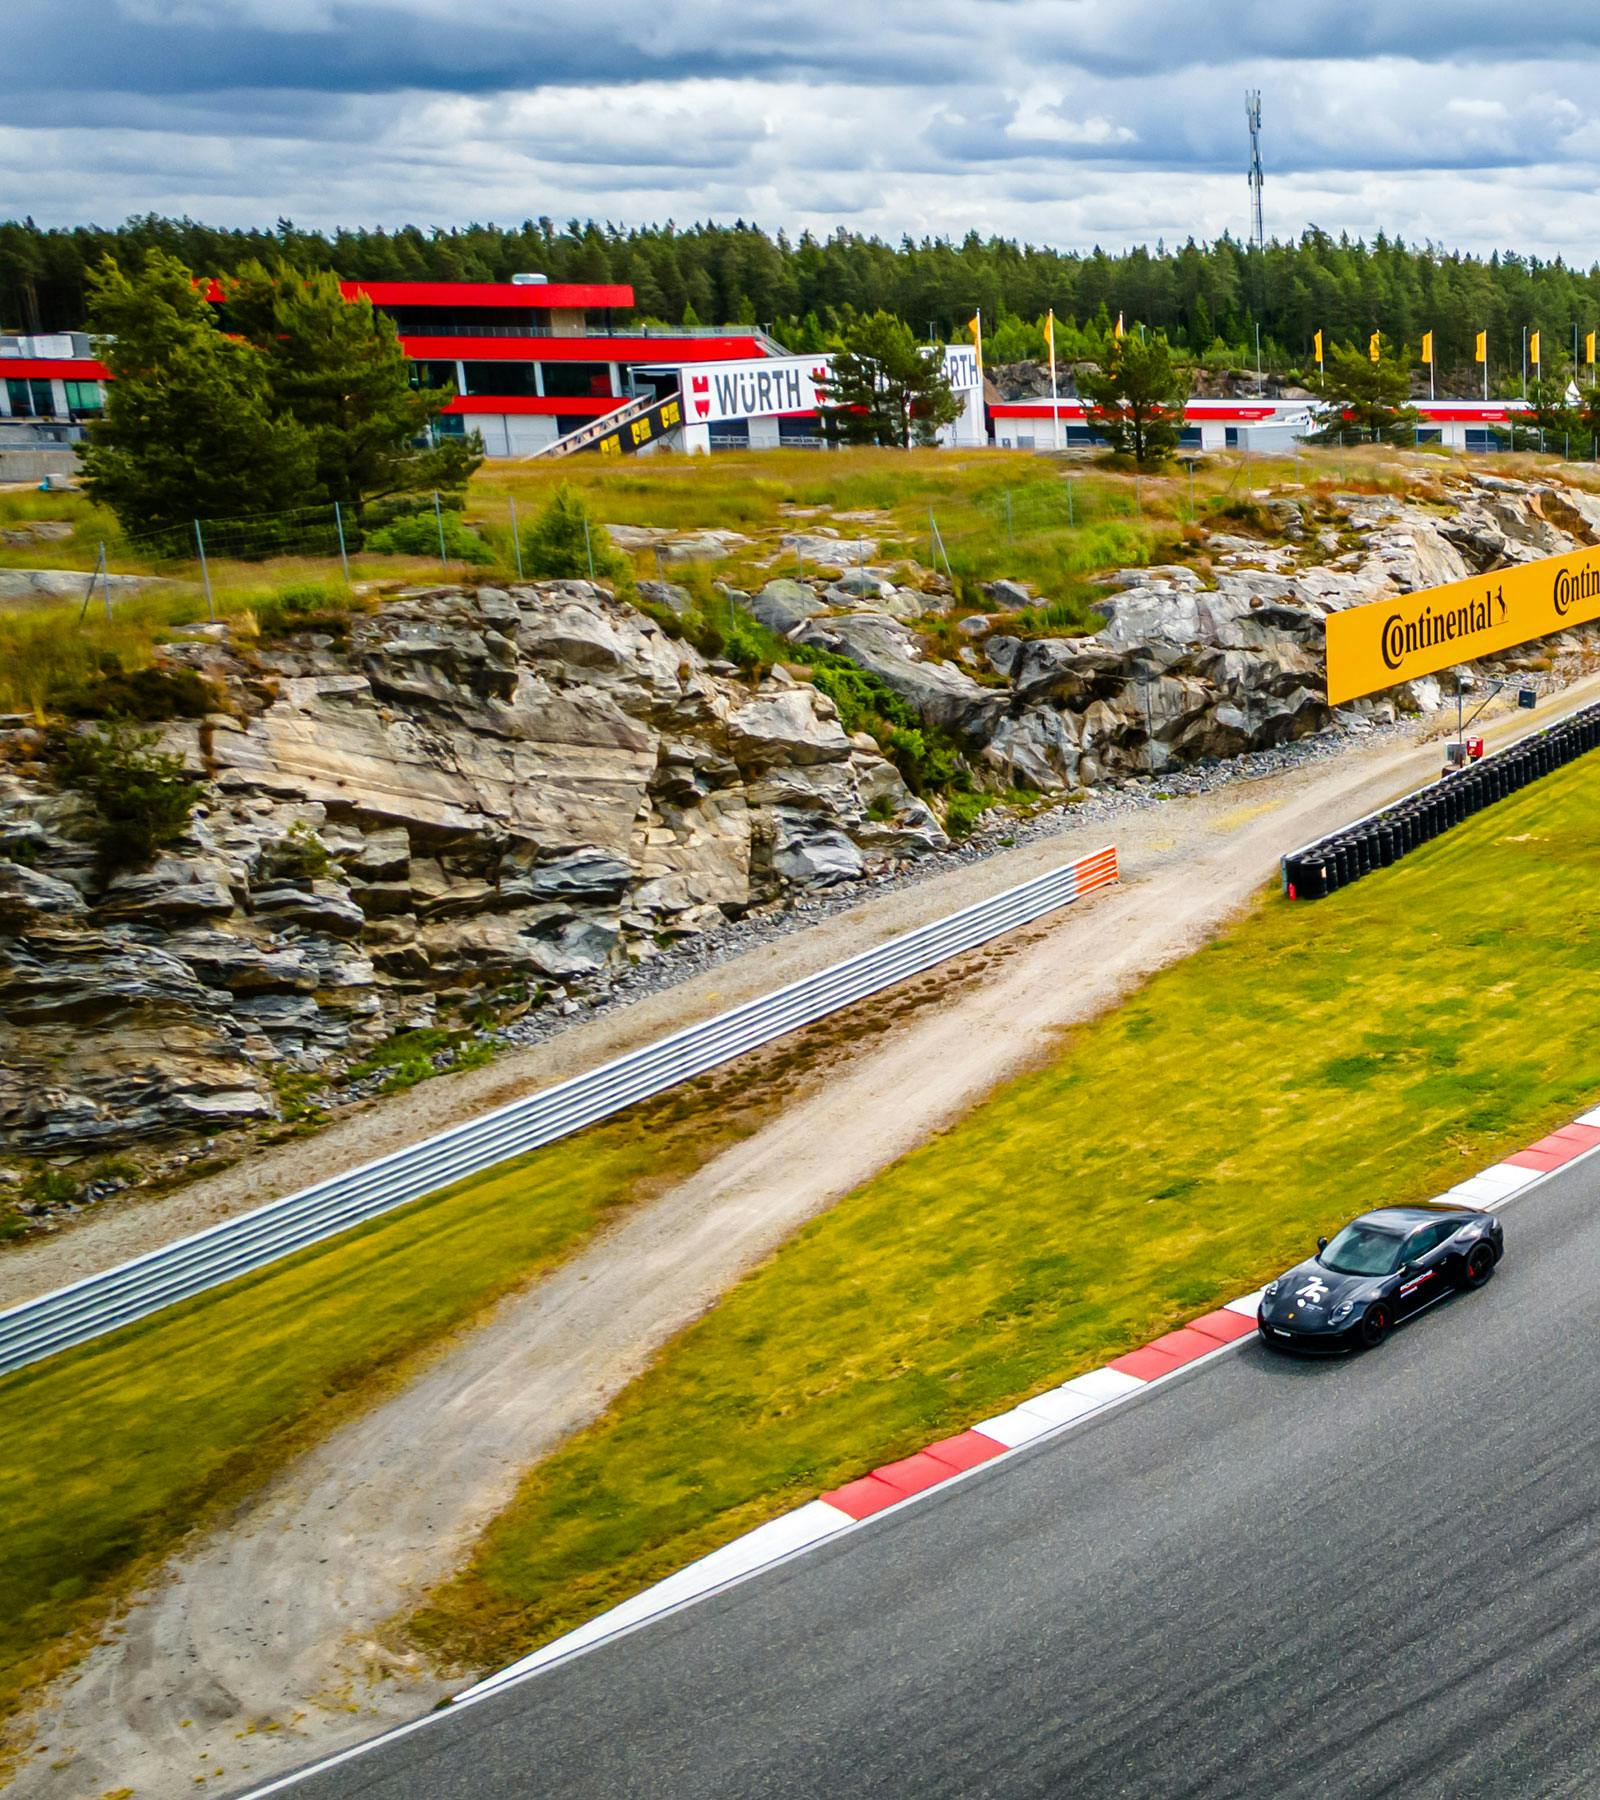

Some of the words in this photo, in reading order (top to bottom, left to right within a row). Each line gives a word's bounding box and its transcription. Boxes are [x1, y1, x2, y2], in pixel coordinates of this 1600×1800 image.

[715, 368, 802, 416] WÜRTH
[941, 354, 979, 388] RTH
[1381, 590, 1493, 671] Continental
